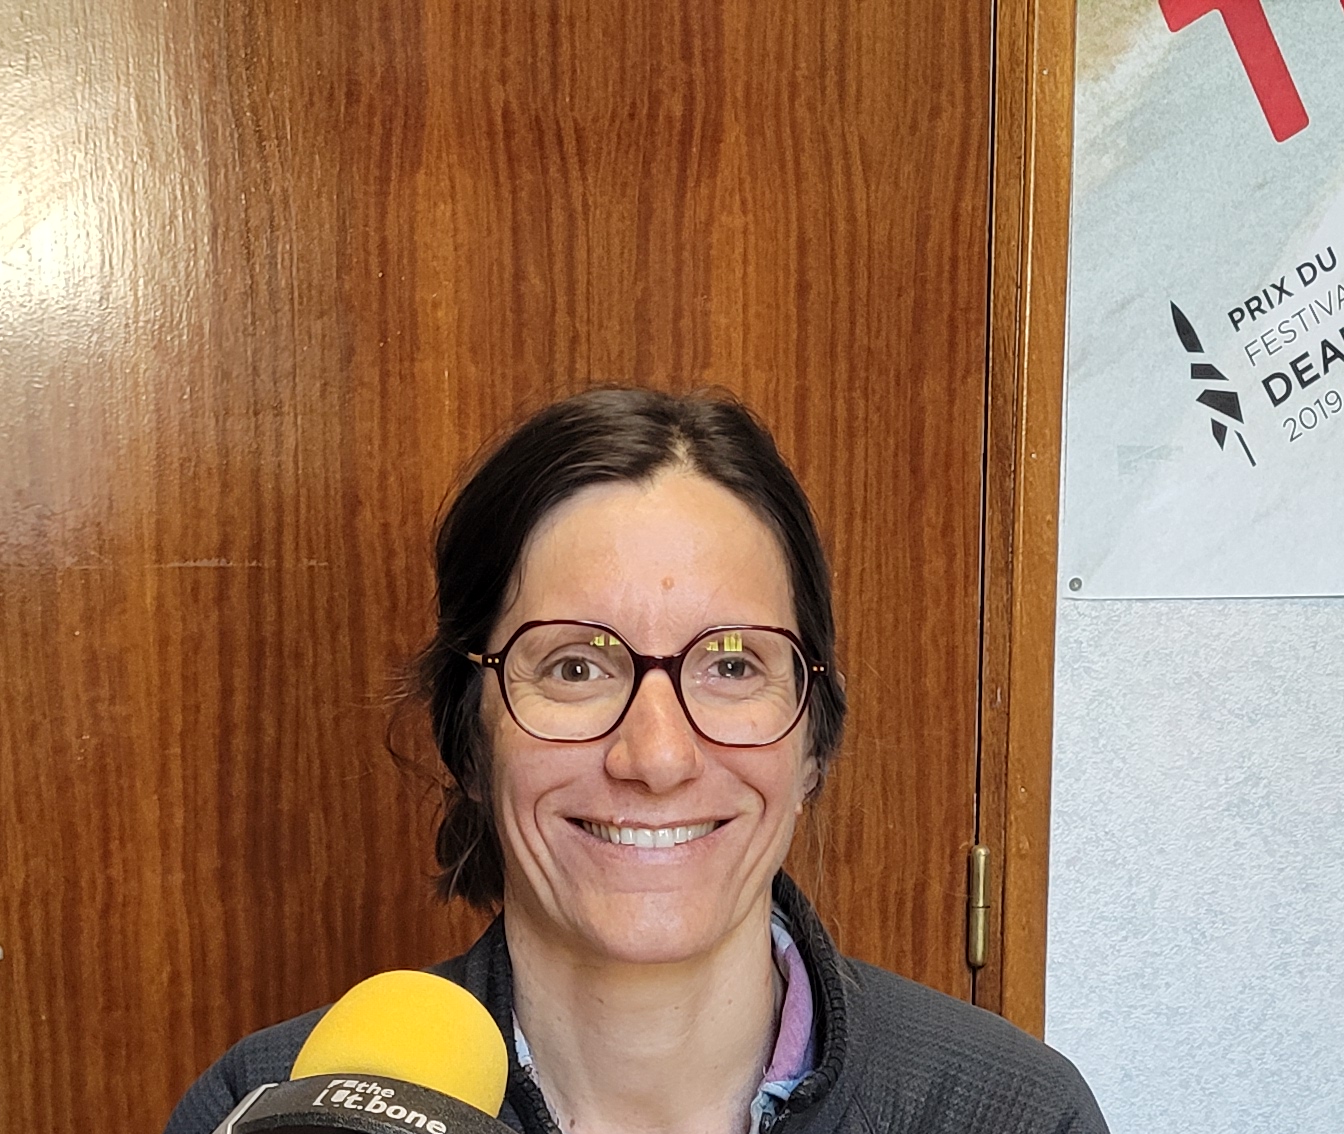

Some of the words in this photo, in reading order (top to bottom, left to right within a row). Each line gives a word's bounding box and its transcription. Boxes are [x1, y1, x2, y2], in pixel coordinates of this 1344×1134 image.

[1226, 274, 1295, 333] PRIX
[1294, 245, 1340, 288] DU
[1281, 387, 1344, 443] 2019
[356, 1083, 395, 1098] the
